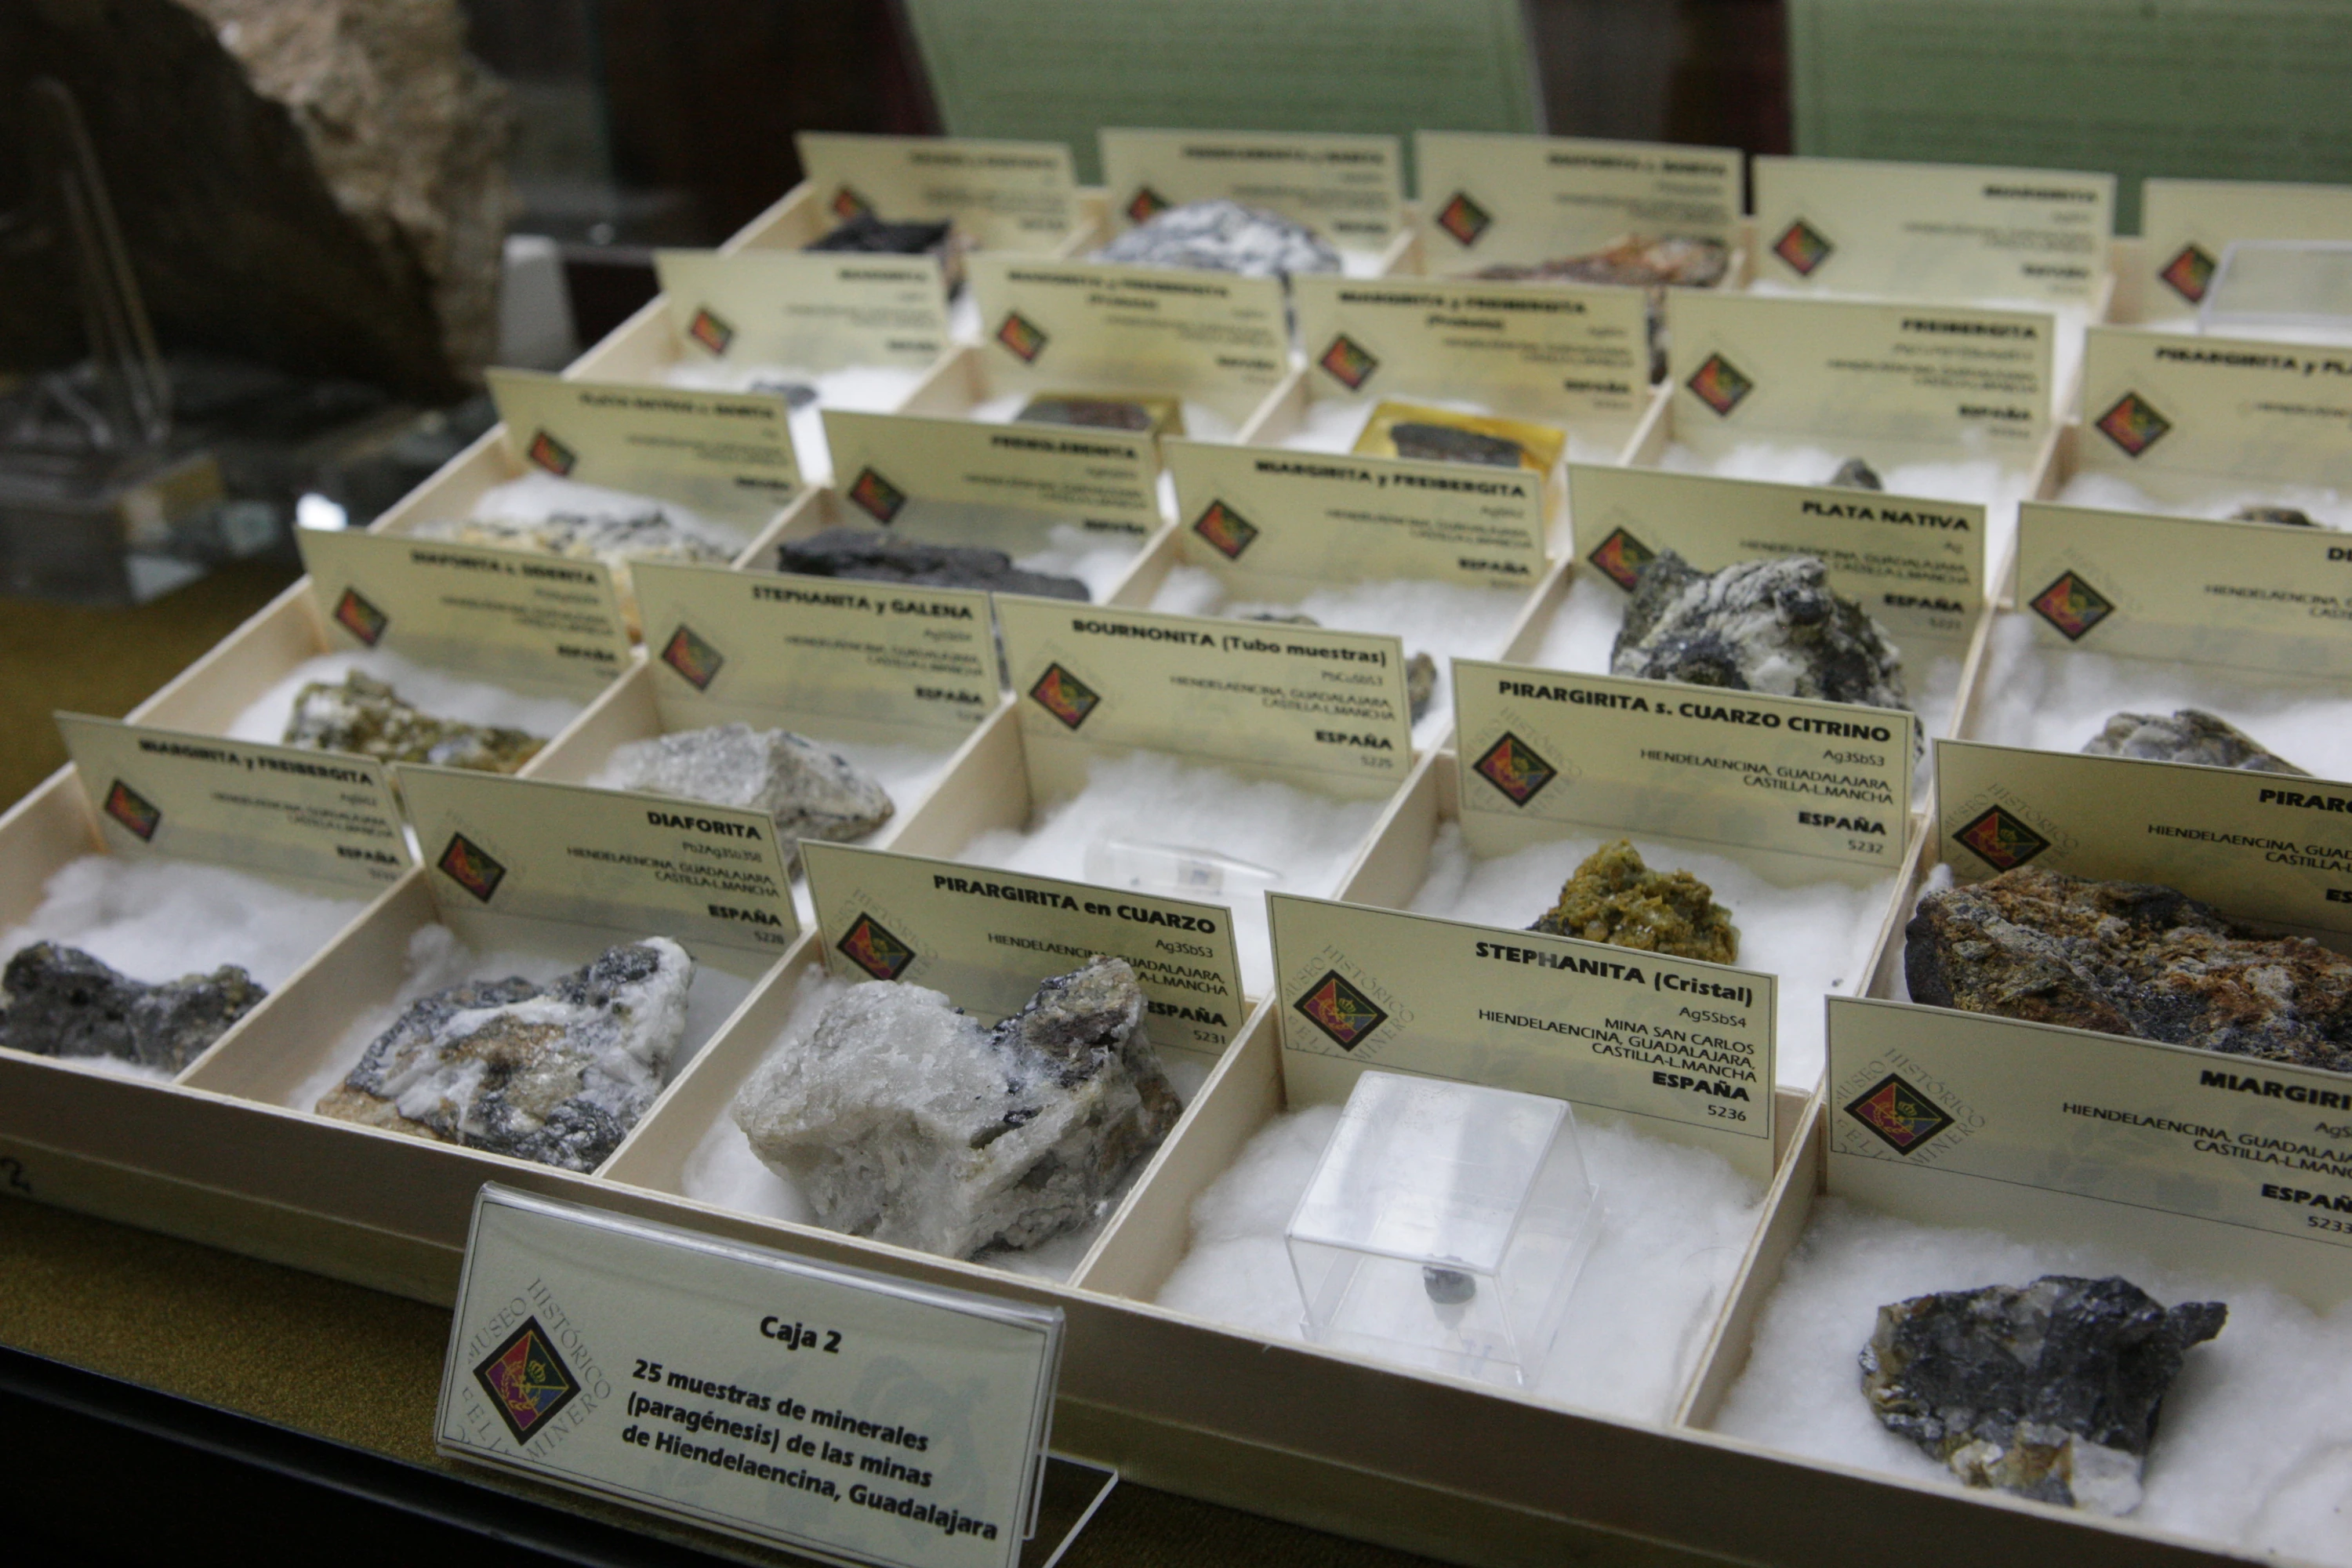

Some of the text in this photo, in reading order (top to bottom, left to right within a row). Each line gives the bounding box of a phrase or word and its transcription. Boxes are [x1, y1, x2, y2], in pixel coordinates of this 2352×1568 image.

[1802, 500, 1970, 532] PLATA NATIVA
[1072, 619, 1388, 668] BOURNONITA (Tubo muestras)
[1498, 680, 1650, 713] PIRARGIRITA
[1679, 703, 1781, 729] CUARZO
[1787, 716, 1892, 743] CITRINO
[1314, 729, 1394, 751] ESPAÑA
[1822, 750, 1886, 768] Ag3SbS3
[646, 811, 762, 840] DIAFORITA
[1798, 809, 1887, 836] ESPAÑA
[2147, 824, 2299, 854] HIENDELAENCINA,
[707, 903, 782, 927] ESPAÑA
[933, 874, 1216, 935] PIRARGIRITA en CUARZO
[988, 933, 1106, 958] HIENDELAENCI
[1155, 938, 1213, 958] Ag3SbS3
[1475, 942, 1753, 1008] STEPHANITA (Cristal)
[1147, 1000, 1227, 1028] ESPAÑA
[1679, 1007, 1747, 1029] Ag5SbS4
[1192, 1029, 1227, 1045] 5231
[1478, 1009, 1755, 1071] HIENDELAENCINA, GUADALAJARA,
[1605, 1018, 1755, 1055] MINA SAN CARLOS
[1592, 1043, 1758, 1083] CASTILLA-L.MANCHA
[1652, 1070, 1751, 1102] ESPAÑA
[2200, 1069, 2351, 1111] MIARGIRI
[1708, 1105, 1748, 1123] 5236
[2063, 1102, 2233, 1143] HIENDELAENCINA,
[467, 1297, 527, 1365] MUSEO
[527, 1277, 611, 1399] HISTÓRICO
[760, 1316, 843, 1354] Caja 2
[632, 1359, 929, 1453] 25 muestras de minerales
[526, 1392, 598, 1463] MINERO
[626, 1390, 933, 1488] (paragénesis) de las minas
[621, 1424, 999, 1541] de Hiendelaencina, Guadalajara
